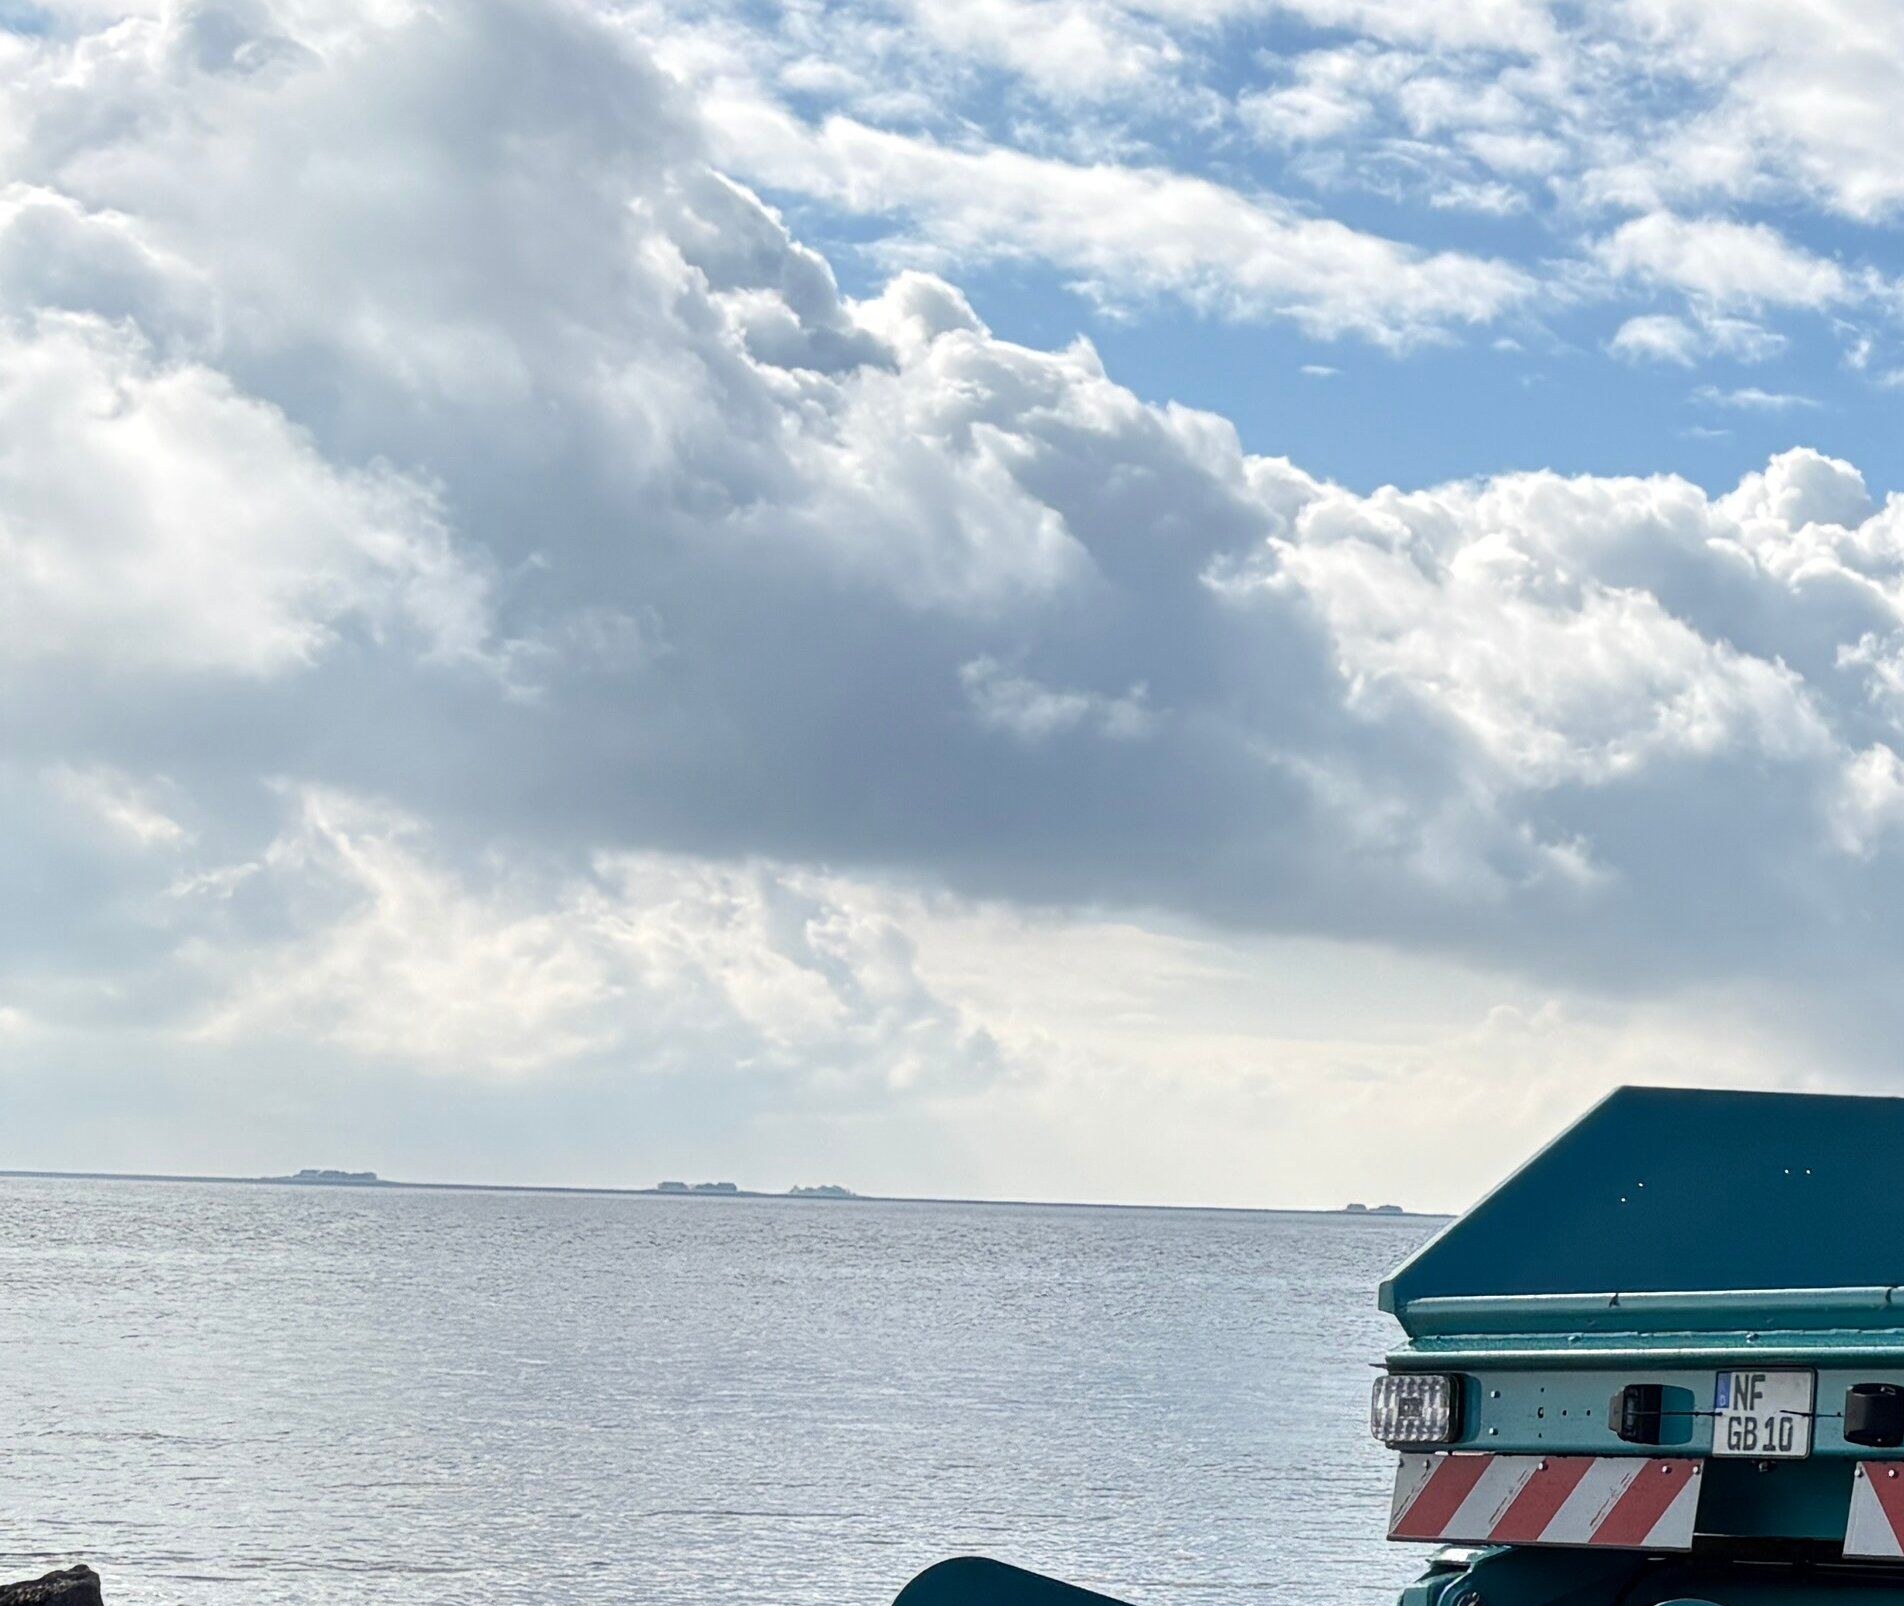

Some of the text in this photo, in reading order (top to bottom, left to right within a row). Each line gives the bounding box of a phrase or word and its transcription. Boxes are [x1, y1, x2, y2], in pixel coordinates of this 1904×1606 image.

[1733, 1374, 1766, 1411] NF
[1727, 1416, 1793, 1452] GB 10
